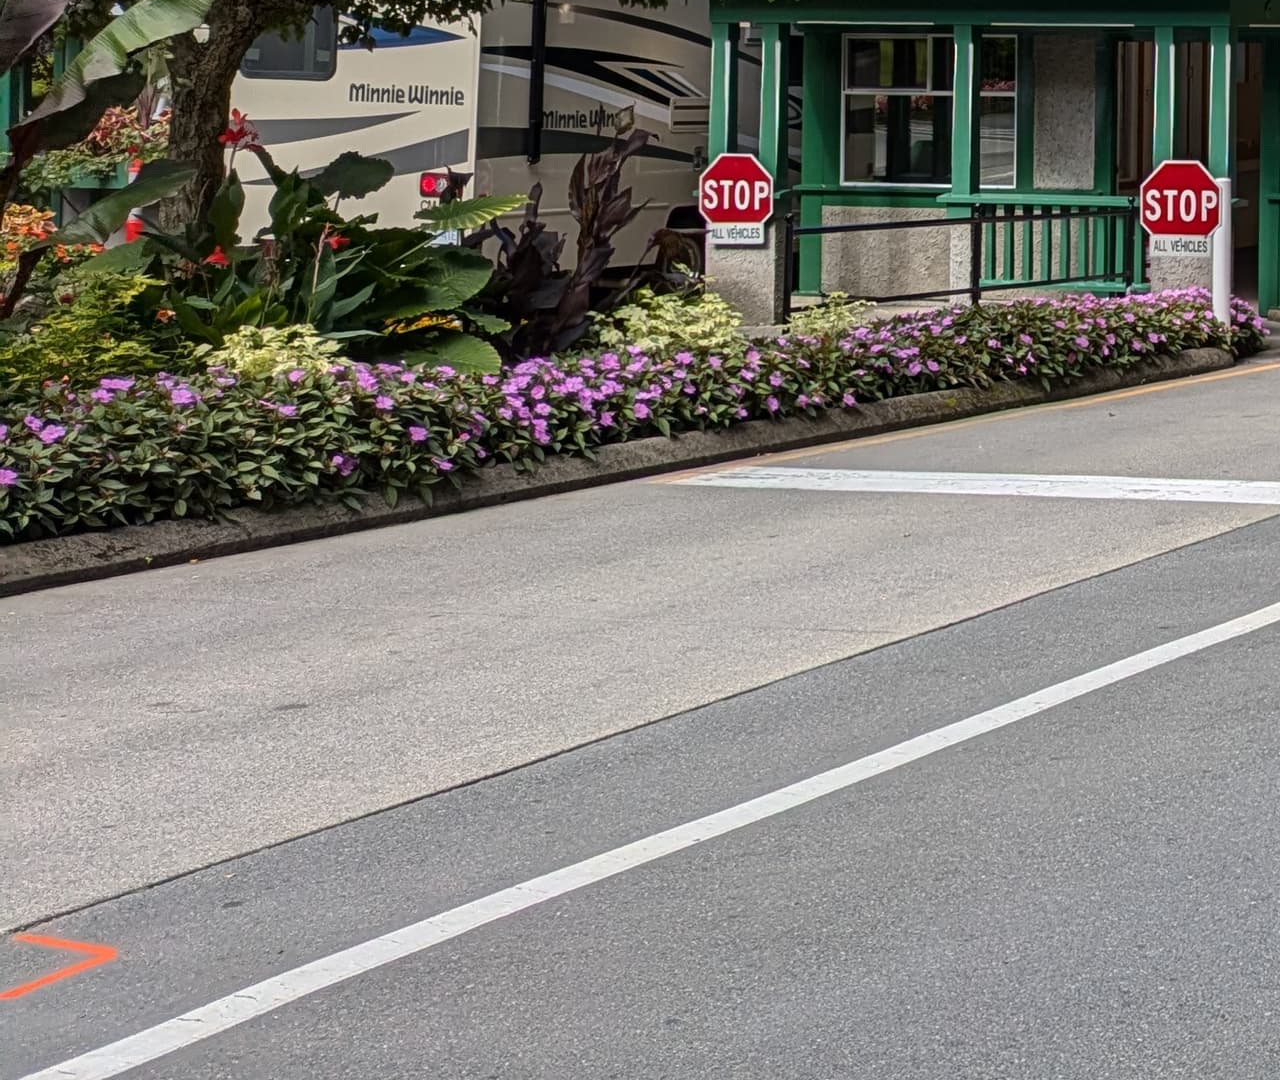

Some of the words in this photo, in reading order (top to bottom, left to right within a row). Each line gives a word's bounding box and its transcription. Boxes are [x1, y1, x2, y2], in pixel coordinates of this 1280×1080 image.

[349, 83, 405, 104] Minnie
[408, 85, 465, 106] Winnie
[704, 179, 769, 211] STOP
[1145, 189, 1218, 222] STOP
[712, 228, 724, 239] ALL
[726, 227, 760, 239] VEHICLES
[1153, 240, 1167, 252] ALL
[1170, 240, 1208, 253] VEHICLES
